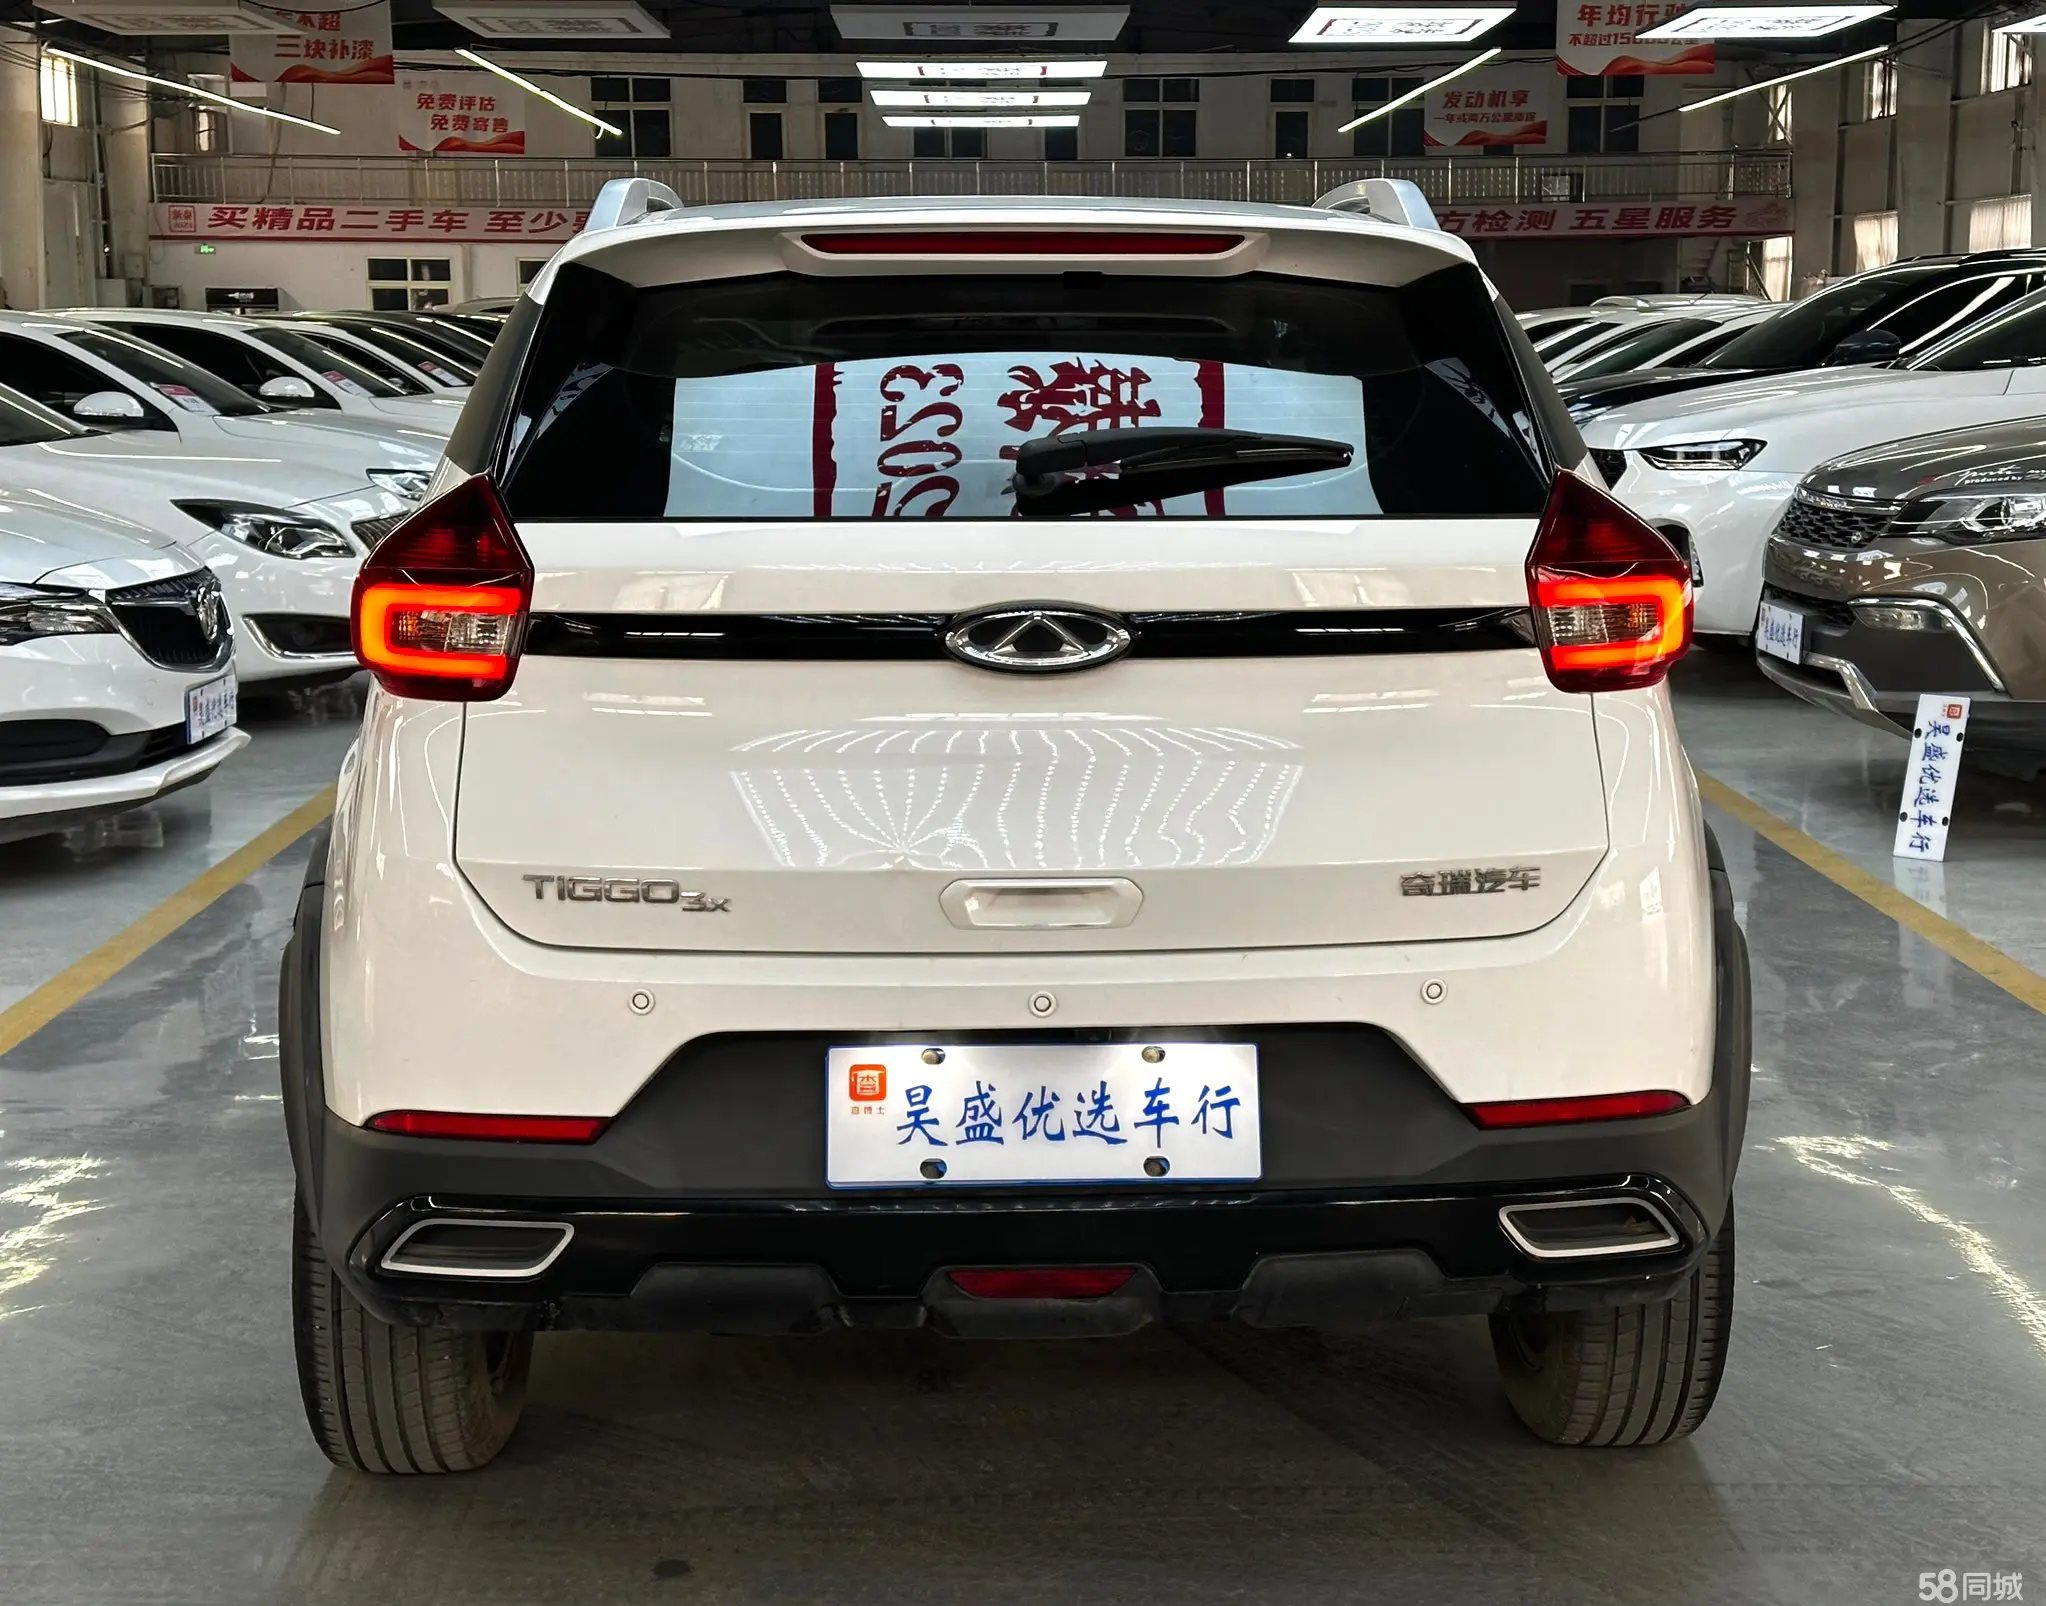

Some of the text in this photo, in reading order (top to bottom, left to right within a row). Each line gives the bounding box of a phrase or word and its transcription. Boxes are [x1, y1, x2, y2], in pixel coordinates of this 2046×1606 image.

[275, 12, 341, 31] 不超
[274, 35, 375, 60] 三块补漆
[416, 92, 496, 112] 免费评估
[1442, 89, 1531, 109] 发动机享
[430, 113, 510, 133] 免费寄售
[208, 206, 470, 233] 买精品二手车
[1568, 205, 1737, 232] 五星服务
[523, 873, 680, 904] TIGGO
[1400, 866, 1541, 896] 奇瑞汽车
[896, 1077, 1241, 1148] 昊盛优选车行
